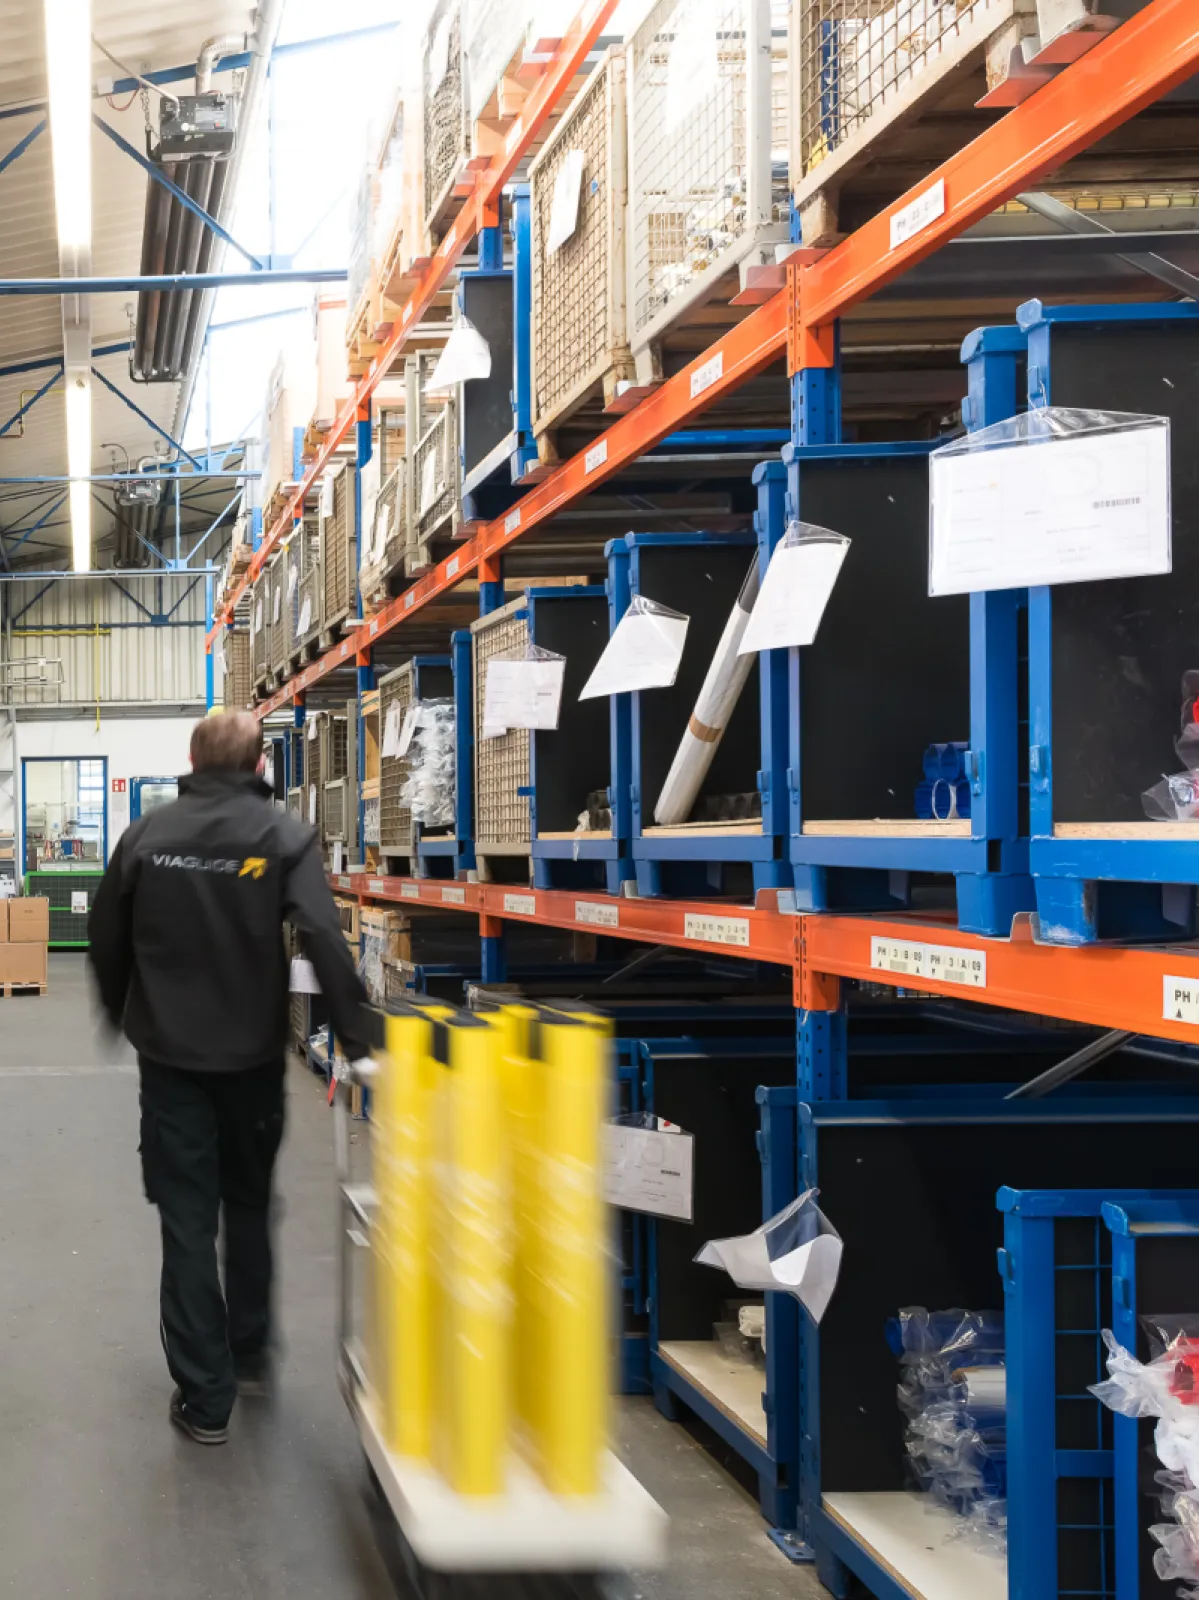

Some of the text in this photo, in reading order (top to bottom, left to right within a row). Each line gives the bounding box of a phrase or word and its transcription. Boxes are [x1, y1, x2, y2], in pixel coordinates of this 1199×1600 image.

[877, 945, 887, 956] PH
[930, 954, 941, 965] PH
[961, 959, 967, 969] A
[1174, 989, 1191, 1003] PH
